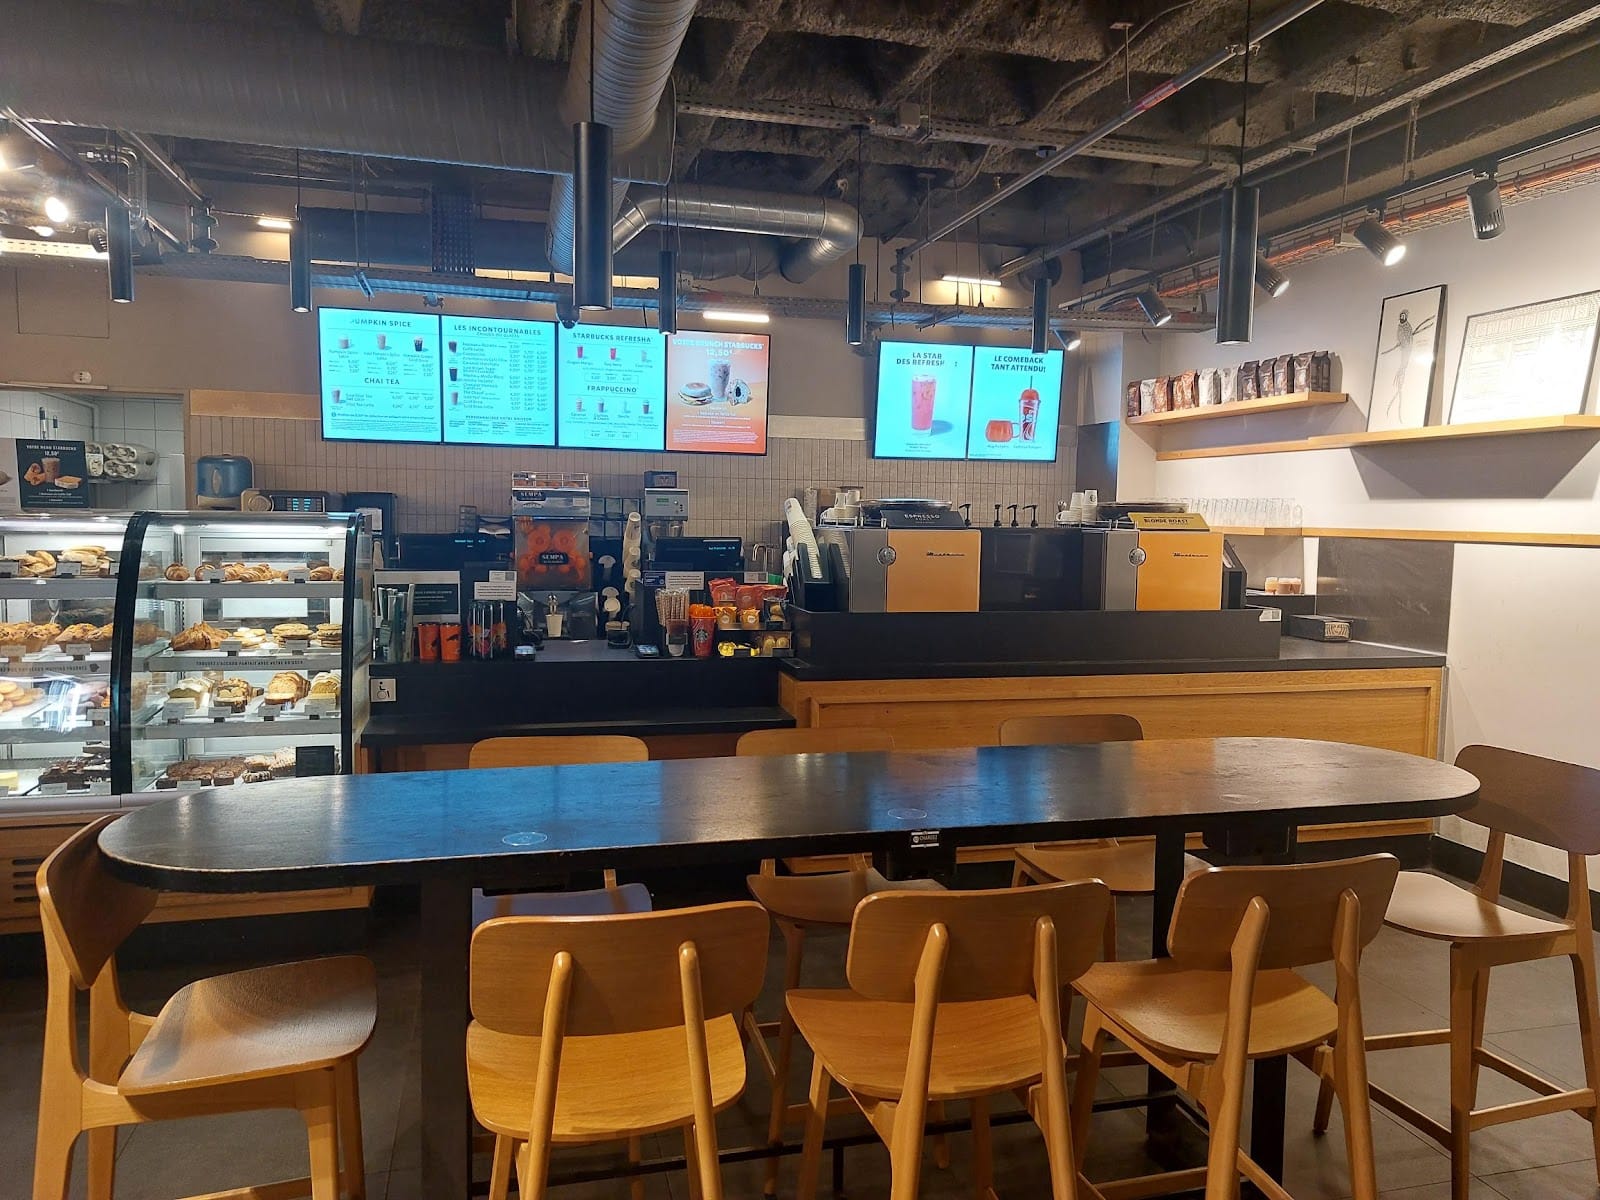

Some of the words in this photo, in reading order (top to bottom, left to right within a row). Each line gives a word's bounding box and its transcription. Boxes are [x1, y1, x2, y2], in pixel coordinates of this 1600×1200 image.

[389, 320, 412, 328] SPICE
[469, 325, 541, 336] INCONTOURNABLES
[572, 332, 614, 341] STARBUCKS
[912, 351, 922, 359] LA
[1003, 355, 1044, 364] COMEBACK
[991, 363, 1010, 371] TANT
[587, 385, 637, 393] FRAPPUCCINO
